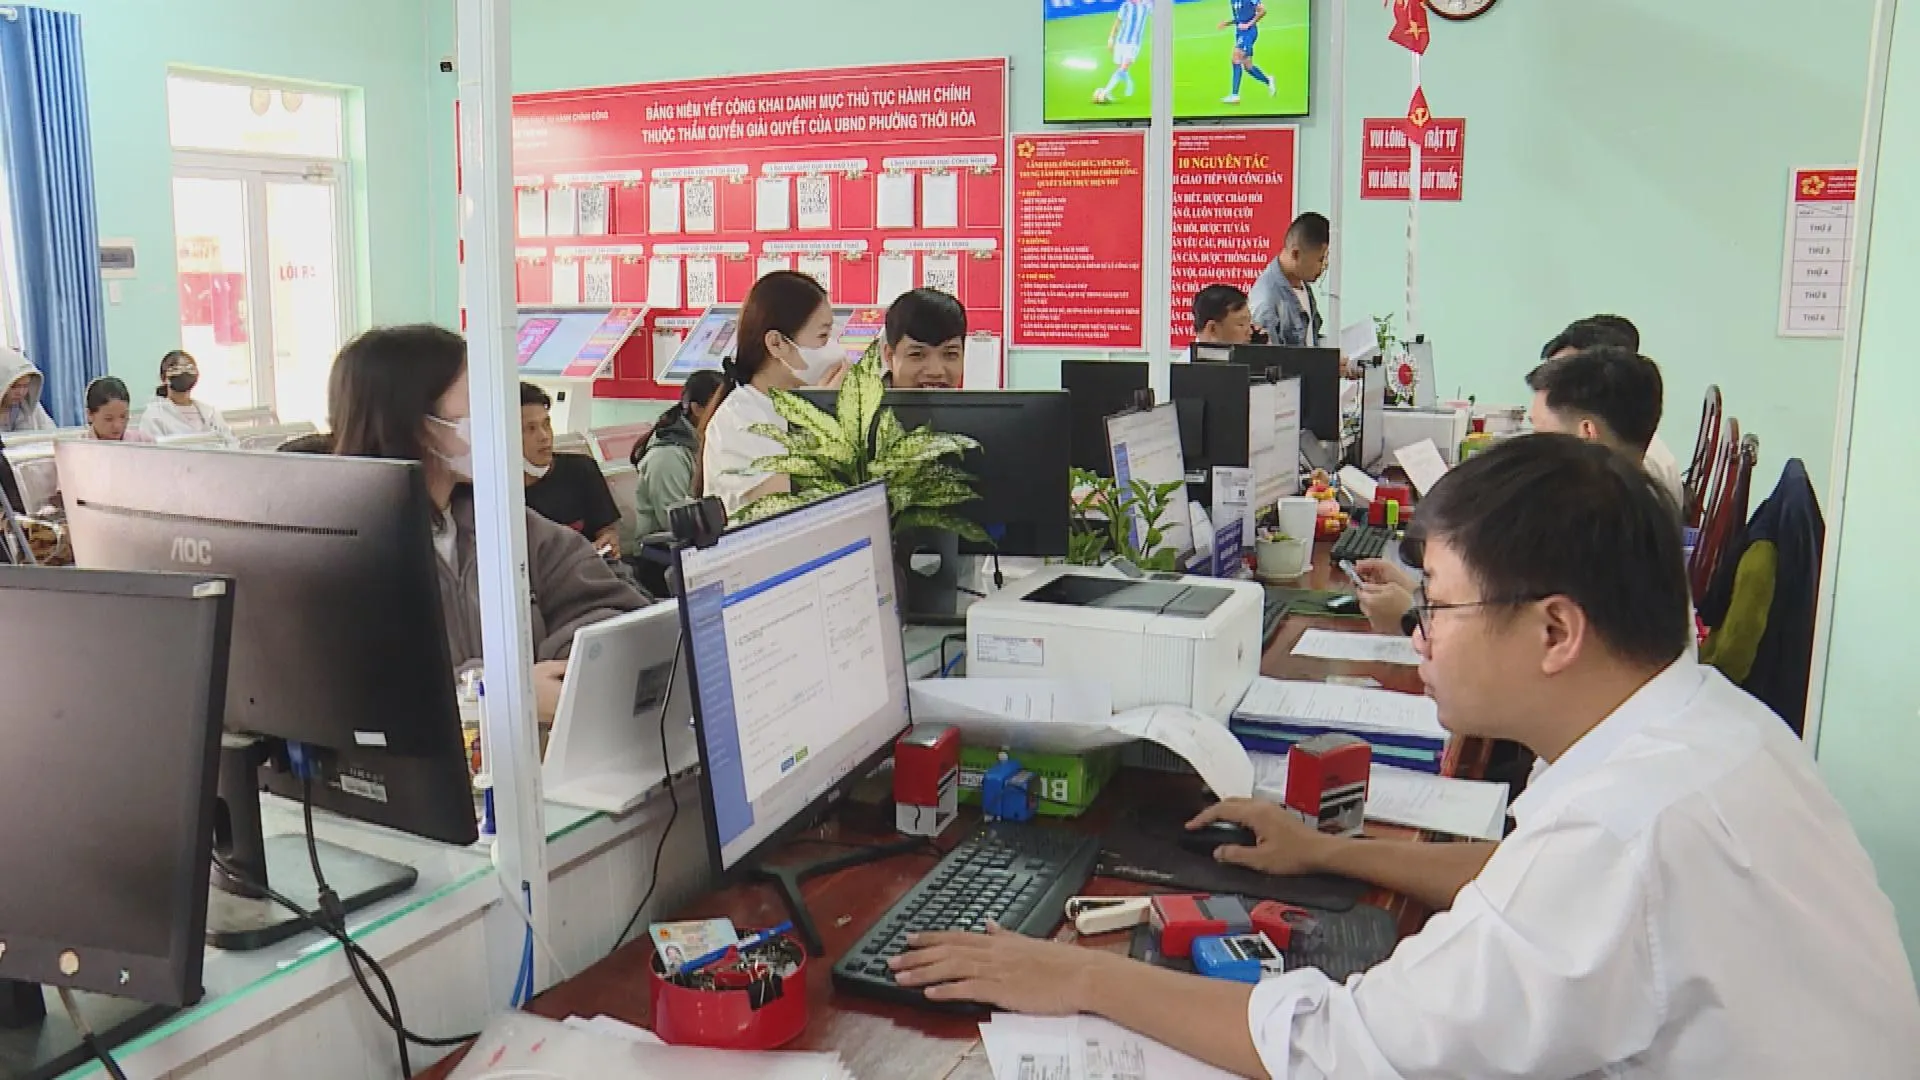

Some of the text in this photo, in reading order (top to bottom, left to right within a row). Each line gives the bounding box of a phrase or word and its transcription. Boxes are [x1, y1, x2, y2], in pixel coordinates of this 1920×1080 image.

[646, 83, 971, 121] BẢNG NIÊM YẾT CÔNG KHAI DANH MỤC THỦ TỤC HÀNH CHÍNH
[642, 107, 976, 144] THUỘC THẨM QUYỀN GIẢI QUYẾT CỦA UBND PHƯỜNG THỚI HÒA
[1370, 129, 1384, 149] VUI
[1385, 126, 1407, 149] LÒNG
[1446, 127, 1458, 152] TỰ
[1178, 157, 1190, 169] 10
[1192, 153, 1241, 169] NGUYÊN
[1180, 173, 1202, 185] GIAO
[1203, 171, 1222, 185] TIẾP
[1222, 171, 1238, 185] VỚI
[1239, 170, 1264, 185] CÔNG
[1265, 170, 1283, 185] DÂN
[1368, 169, 1380, 189] VUI
[1242, 266, 1262, 277] NHAN
[171, 535, 213, 566] AOC
